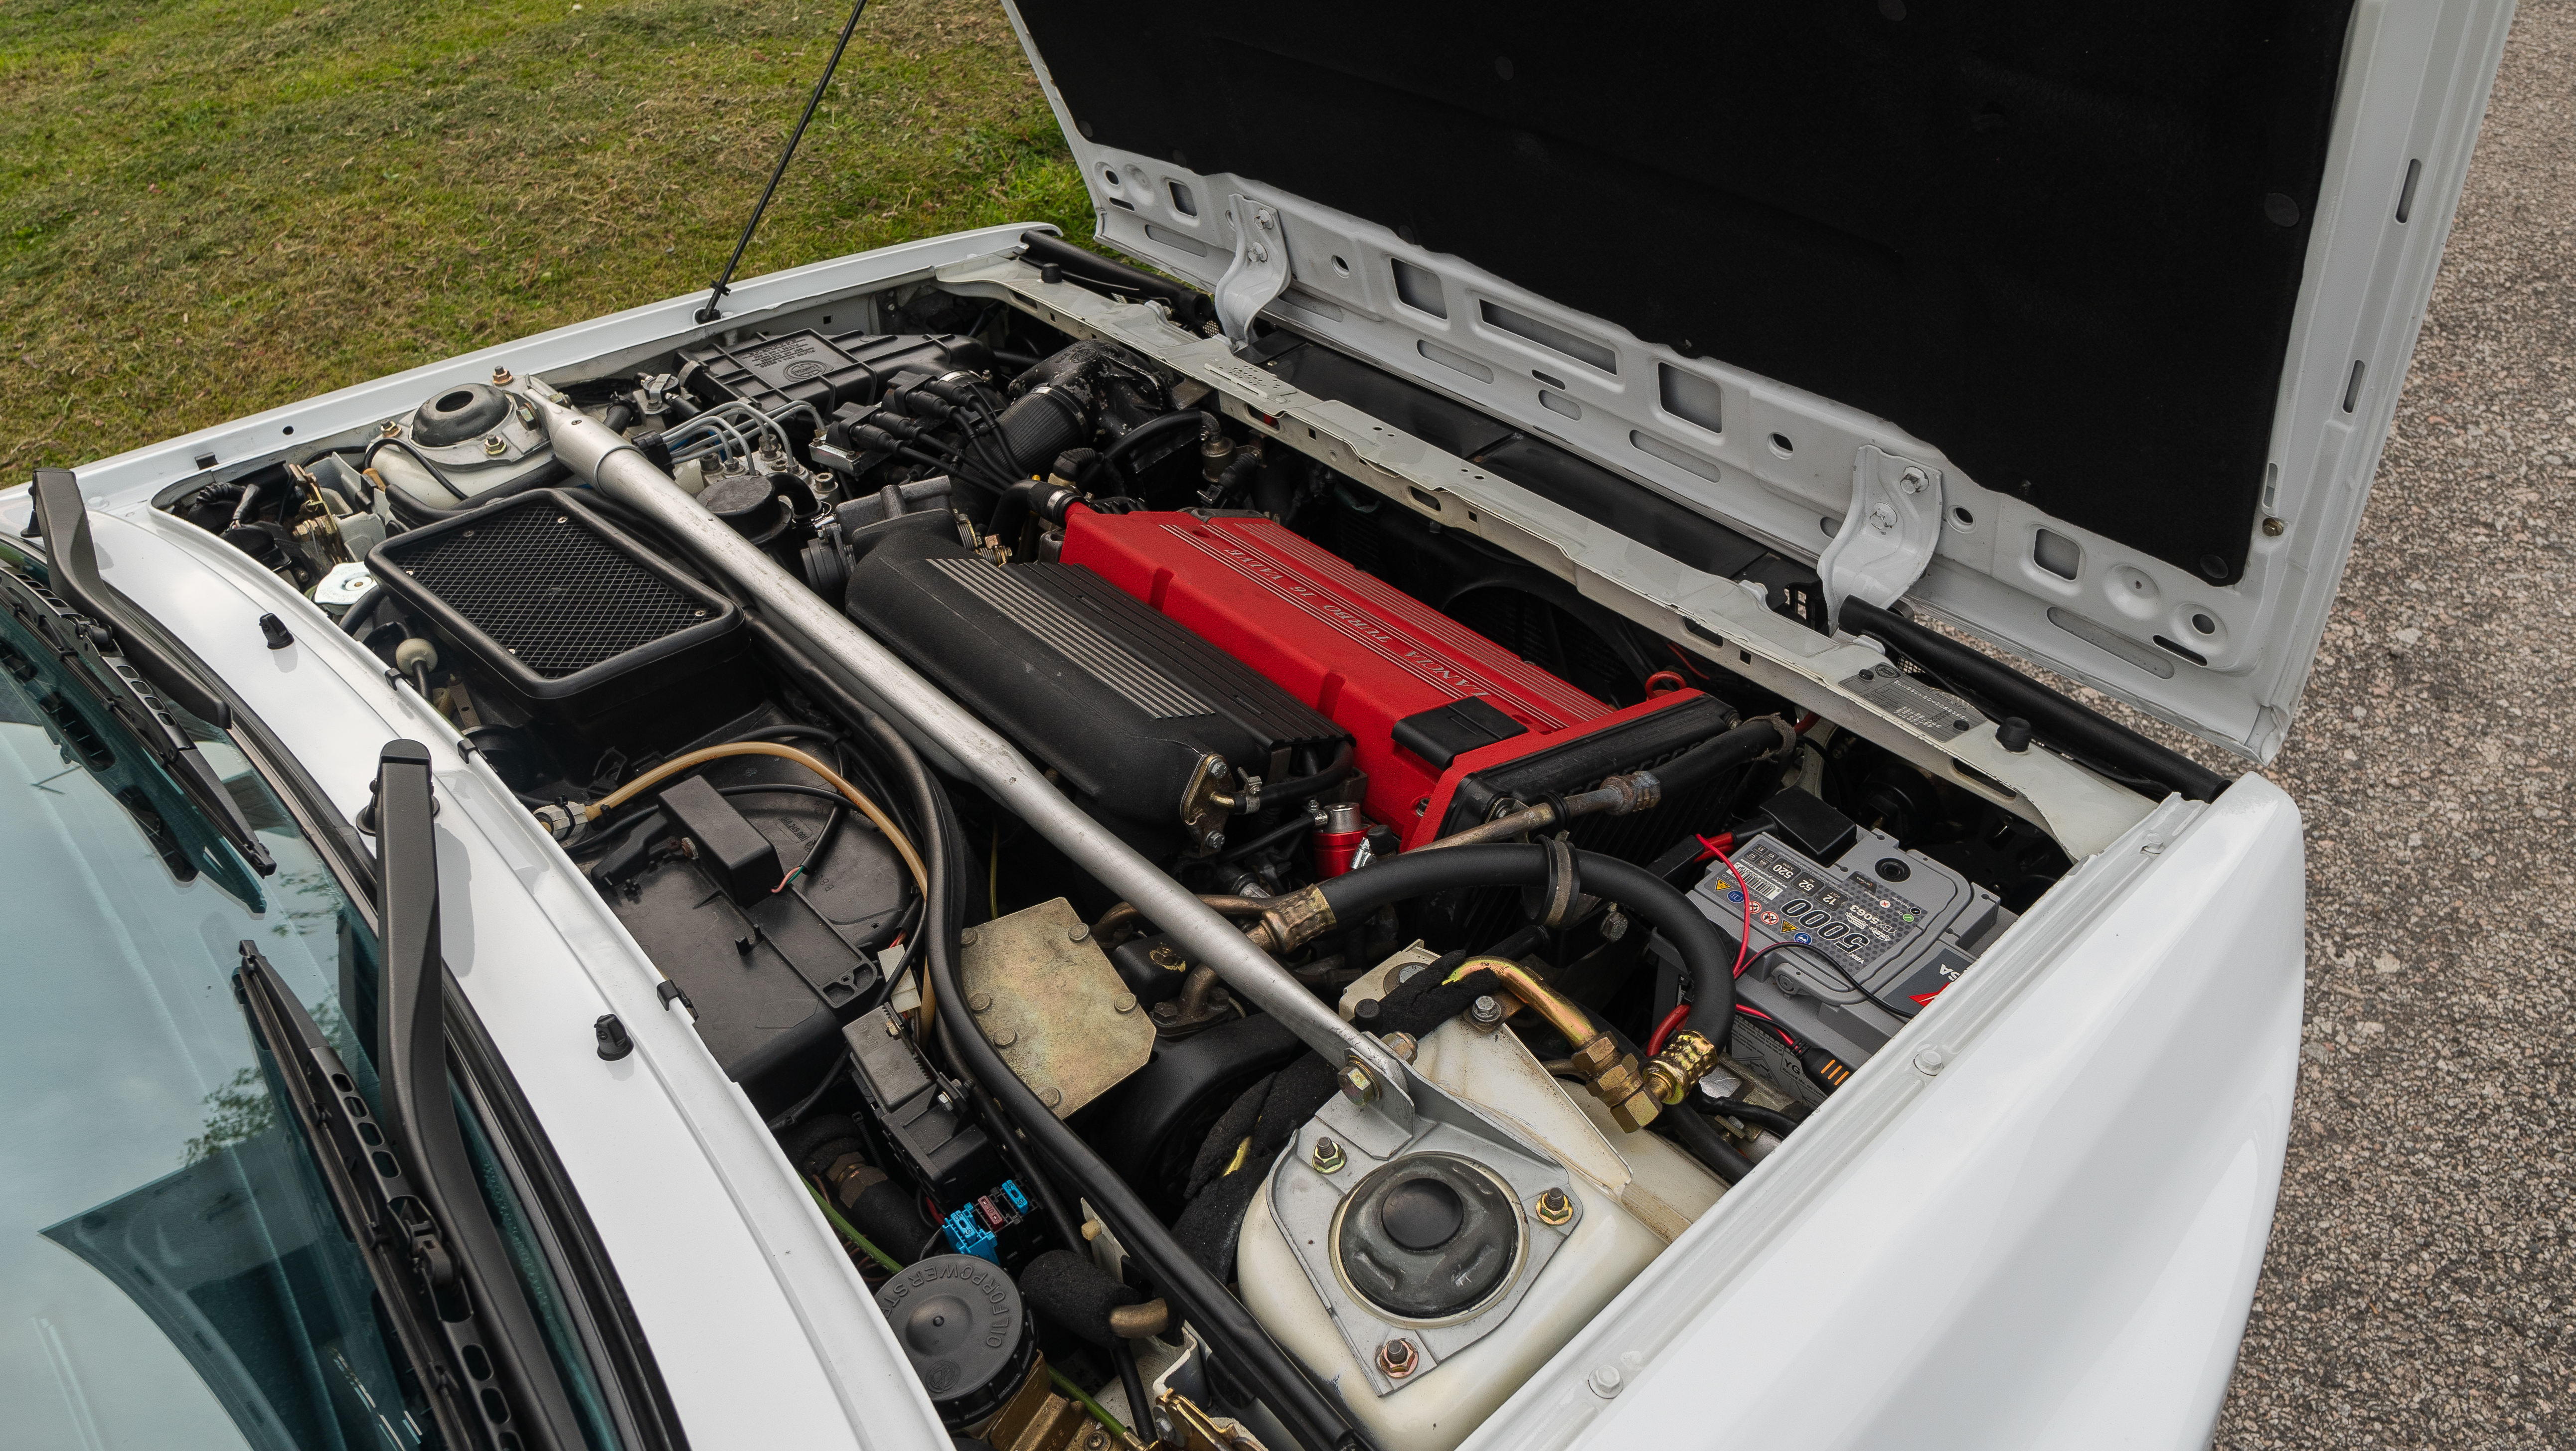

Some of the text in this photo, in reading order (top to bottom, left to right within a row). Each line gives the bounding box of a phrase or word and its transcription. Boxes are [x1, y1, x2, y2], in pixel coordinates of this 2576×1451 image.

[1224, 548, 1491, 697] LANCIA TURBO 16 VALVE
[1920, 684, 1934, 693] FIAT
[1934, 692, 1952, 703] AUTO
[1777, 851, 1794, 861] STANDARD
[1739, 857, 1788, 889] www.yuasa.com
[1771, 863, 1794, 879] 520
[1793, 860, 1810, 871] EUROPEAN
[1797, 878, 1814, 891] 52
[1827, 880, 1854, 897] MANUFACTURED
[1746, 888, 1769, 904] ROLLOVE
[1822, 893, 1837, 906] 12
[1863, 890, 1880, 902] Replace
[1891, 895, 1911, 909] Recharge
[1849, 904, 1897, 936] YBX5063
[1780, 897, 1870, 964] YBX 5000
[1782, 1067, 1798, 1080] Record
[1784, 1058, 1801, 1075] YG
[986, 1205, 995, 1214] 10
[908, 1264, 988, 1288] POWER
[982, 1279, 1010, 1315] FOR
[986, 1316, 1010, 1348] OIL
